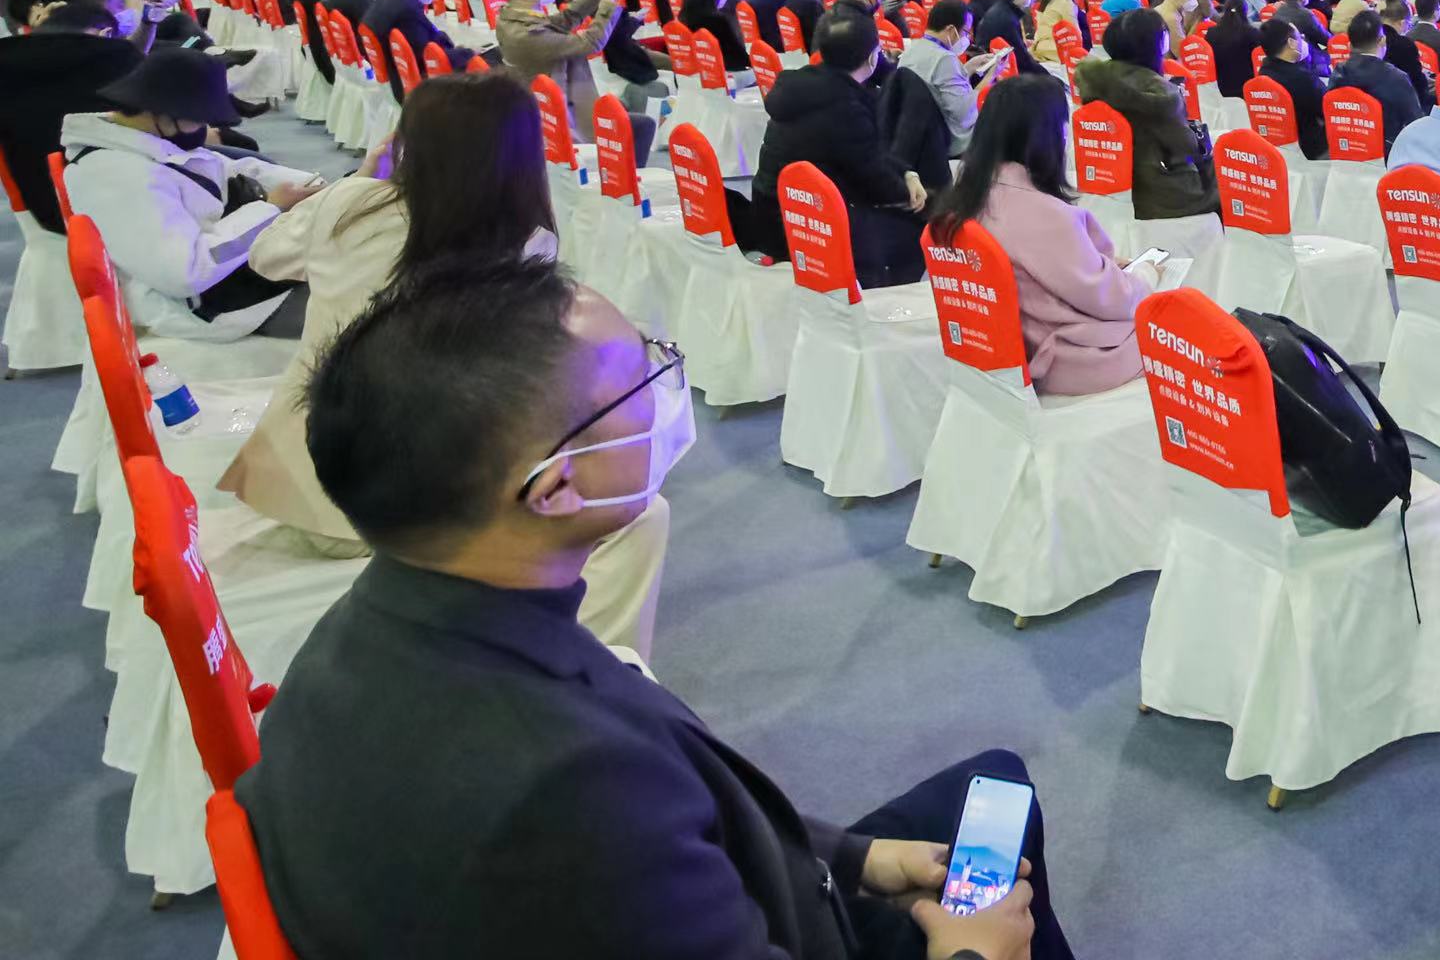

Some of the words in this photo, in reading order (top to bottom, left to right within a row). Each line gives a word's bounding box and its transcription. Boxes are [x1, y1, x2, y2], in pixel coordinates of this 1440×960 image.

[1225, 148, 1257, 165] Tensun
[786, 186, 814, 206] Tensun
[1387, 189, 1430, 204] Tensun
[1148, 322, 1205, 367] Tensun
